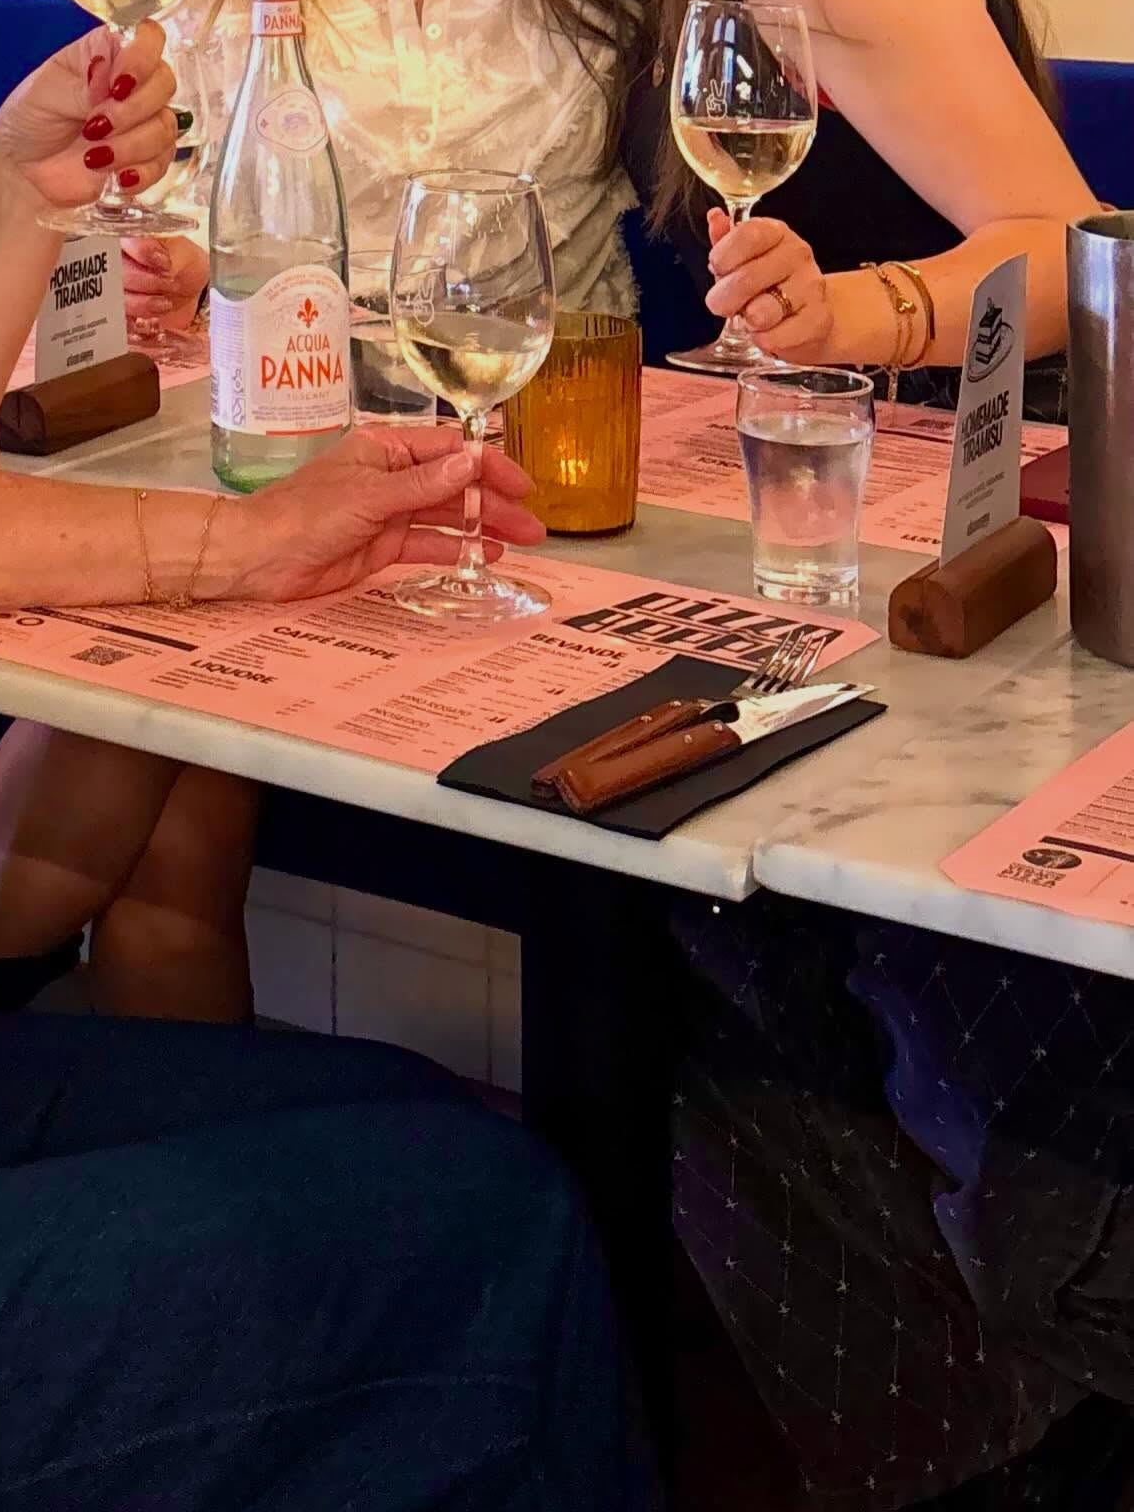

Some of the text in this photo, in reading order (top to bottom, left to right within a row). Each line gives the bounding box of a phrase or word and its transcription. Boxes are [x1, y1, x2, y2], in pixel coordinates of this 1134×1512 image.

[49, 251, 109, 291] HOMEMADE
[54, 275, 103, 311] TIRAMISU
[286, 334, 331, 354] ACQUA
[260, 352, 344, 390] PANNA
[961, 389, 1010, 443] HOMEMADE
[962, 419, 1004, 468] TIRAMISU
[332, 639, 400, 661] BEPPE
[529, 633, 627, 660] BEVANDE
[189, 659, 278, 685] LIQUORE
